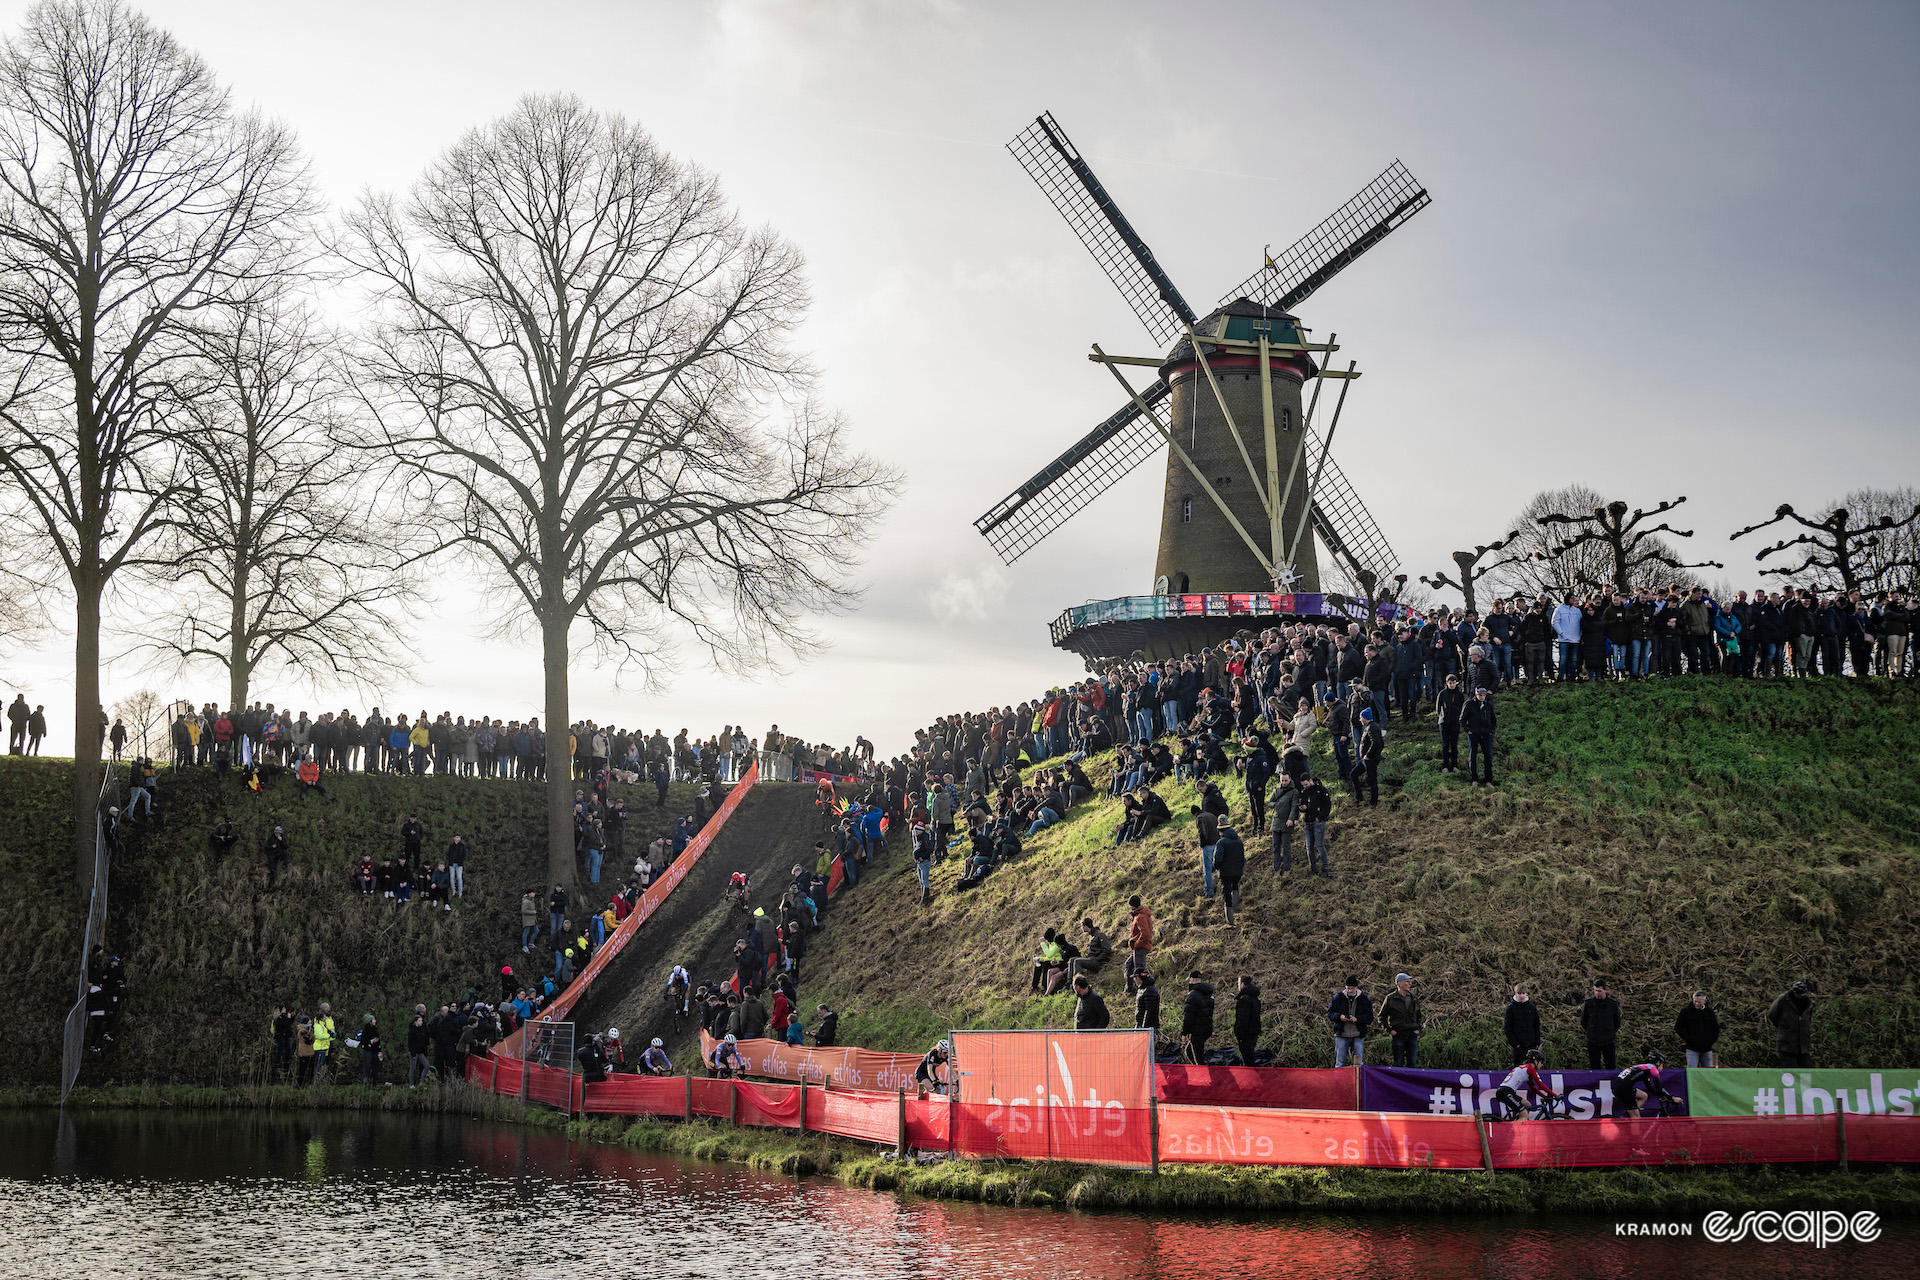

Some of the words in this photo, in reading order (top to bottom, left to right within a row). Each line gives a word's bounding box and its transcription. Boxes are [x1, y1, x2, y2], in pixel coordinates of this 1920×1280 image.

[637, 893, 659, 925] ethias
[762, 1041, 787, 1078] ethias
[797, 1046, 823, 1081] ethias
[834, 1047, 862, 1087] ethias
[877, 1053, 914, 1092] ethias
